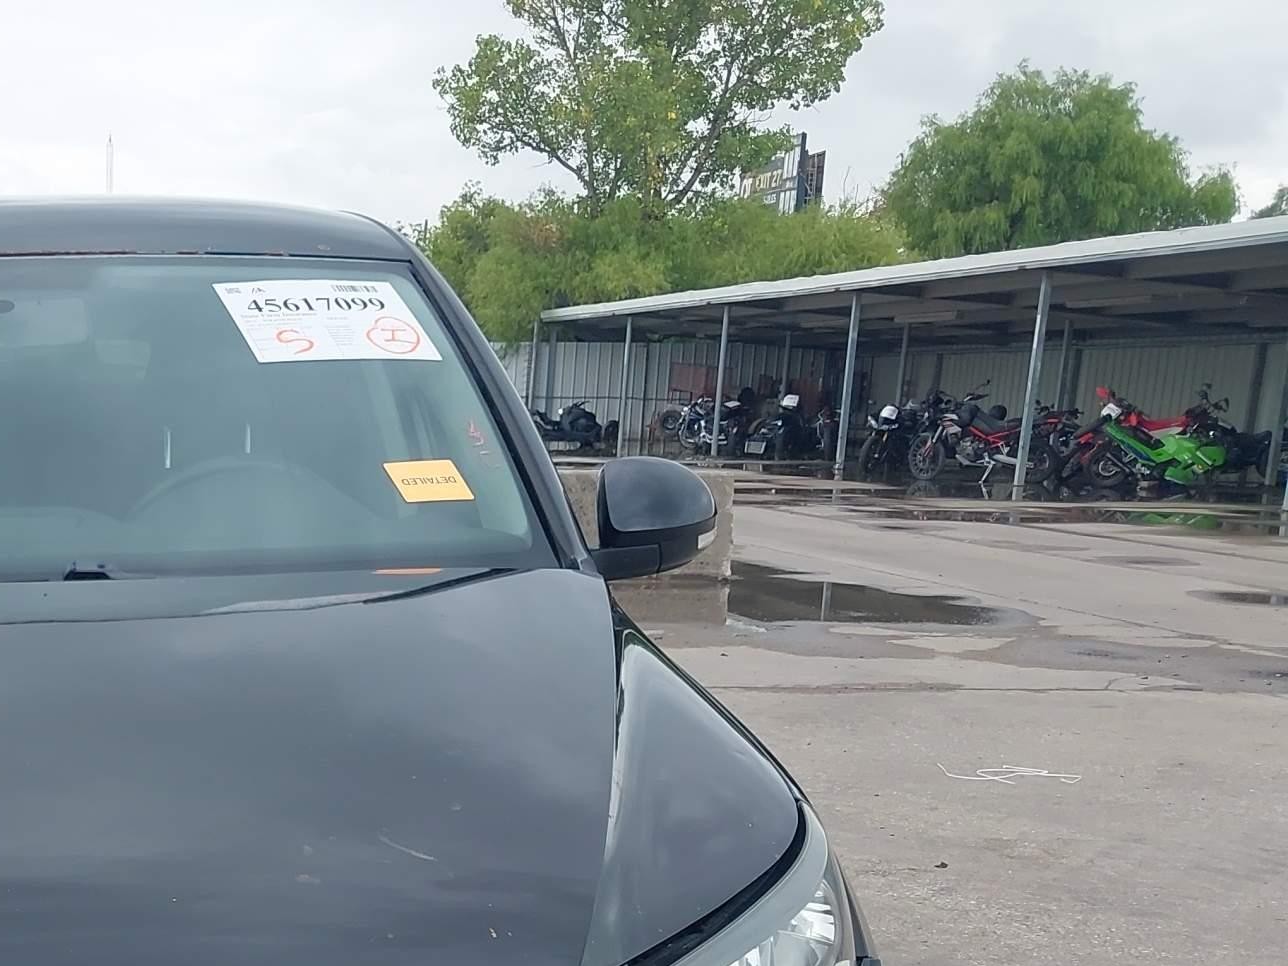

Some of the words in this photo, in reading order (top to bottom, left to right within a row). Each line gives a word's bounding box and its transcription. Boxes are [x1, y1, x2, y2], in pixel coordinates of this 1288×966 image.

[247, 297, 385, 313] 45617099
[276, 329, 314, 355] S
[400, 475, 457, 486] DETAILED
